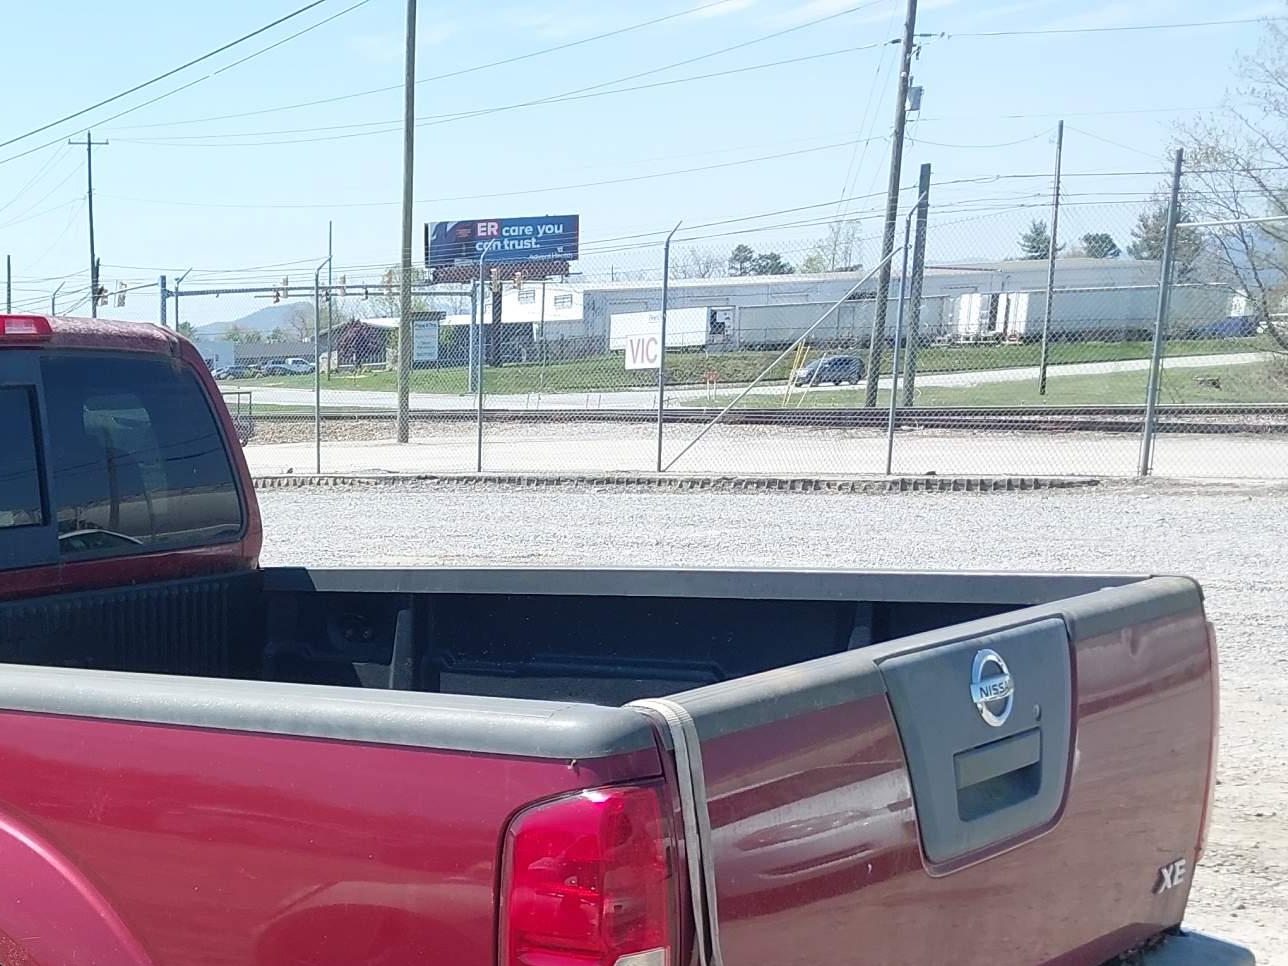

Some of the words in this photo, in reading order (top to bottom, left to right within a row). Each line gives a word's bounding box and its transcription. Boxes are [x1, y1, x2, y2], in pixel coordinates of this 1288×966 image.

[477, 222, 499, 236] ER
[502, 225, 533, 236] care
[537, 223, 563, 237] you
[475, 240, 500, 251] can
[502, 237, 541, 251] trust.
[629, 336, 658, 365] VIC
[979, 680, 1010, 699] NISSA
[1156, 858, 1187, 895] XE
